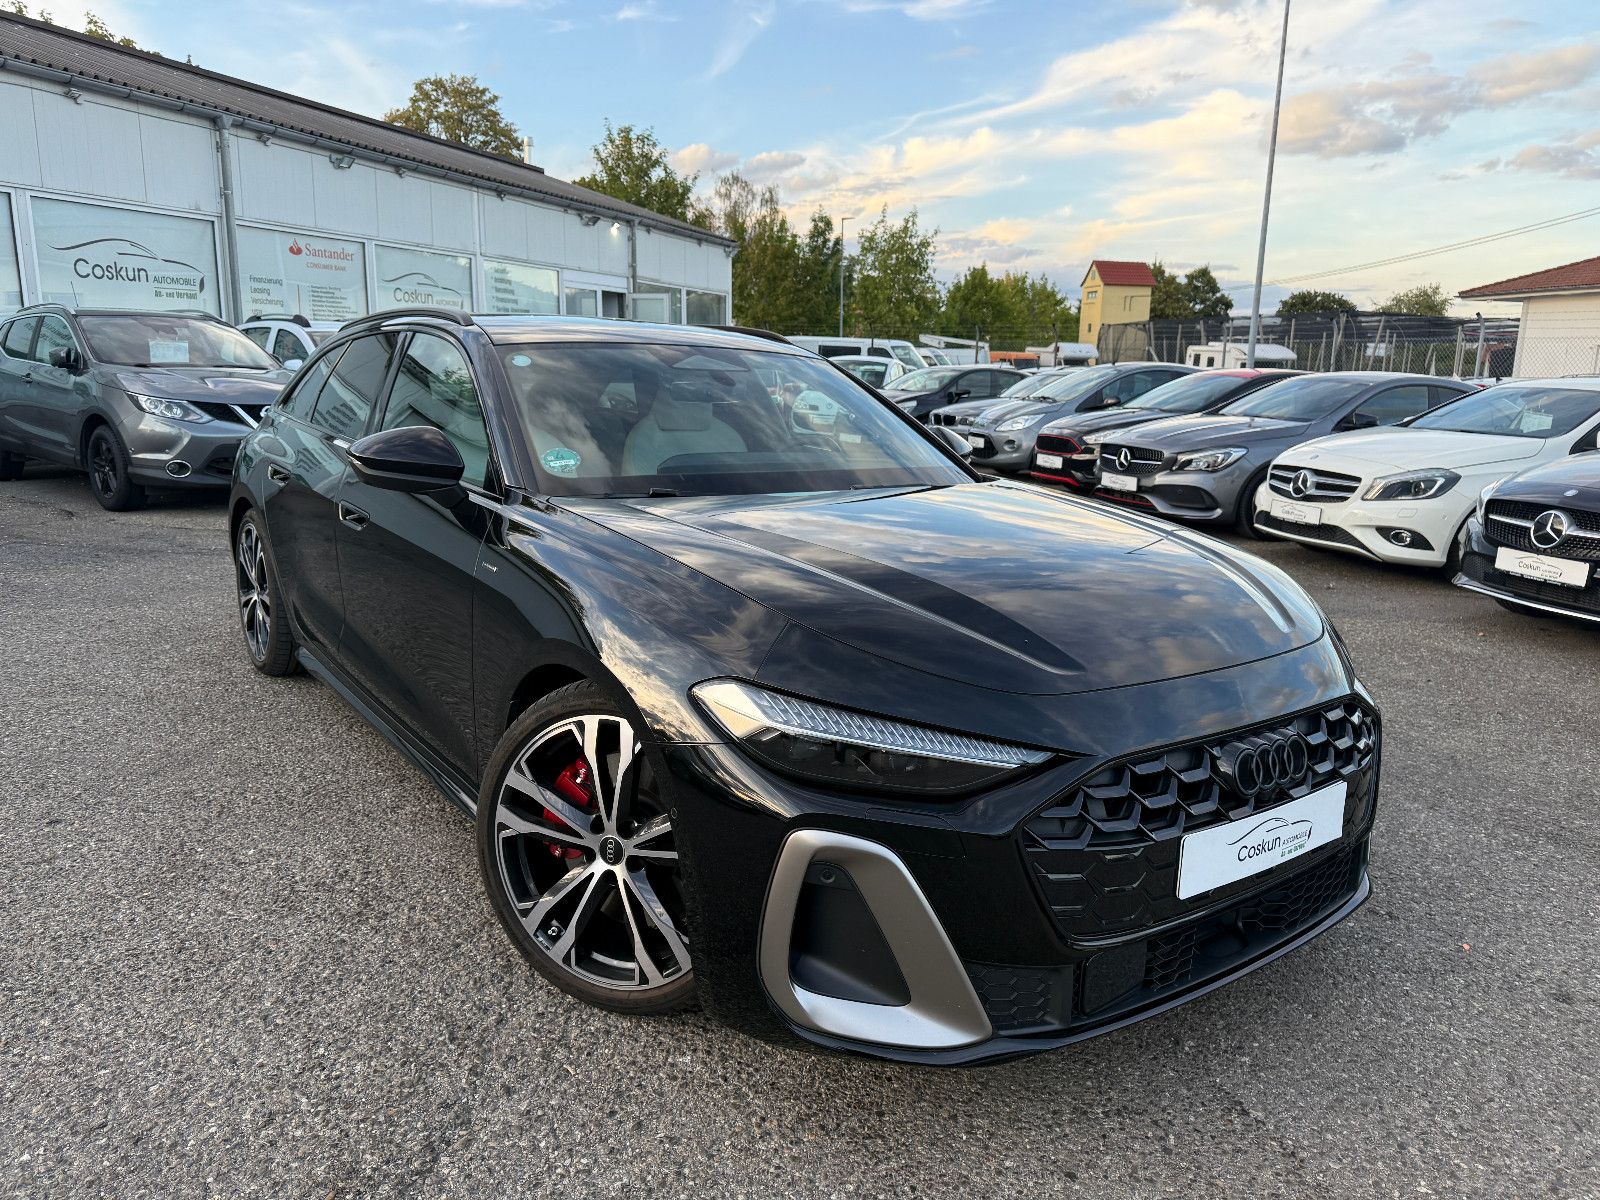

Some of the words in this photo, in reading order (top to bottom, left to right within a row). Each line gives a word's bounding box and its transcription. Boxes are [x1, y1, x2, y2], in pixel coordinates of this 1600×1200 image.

[304, 243, 354, 261] Santander
[73, 258, 149, 283] Coskun
[153, 275, 197, 287] AUTOMOBILE
[249, 274, 283, 287] Finanzierung
[250, 285, 271, 296] Leasing
[393, 287, 434, 305] Coskun
[1518, 560, 1541, 572] Coskun
[1237, 835, 1281, 862] Coskun
